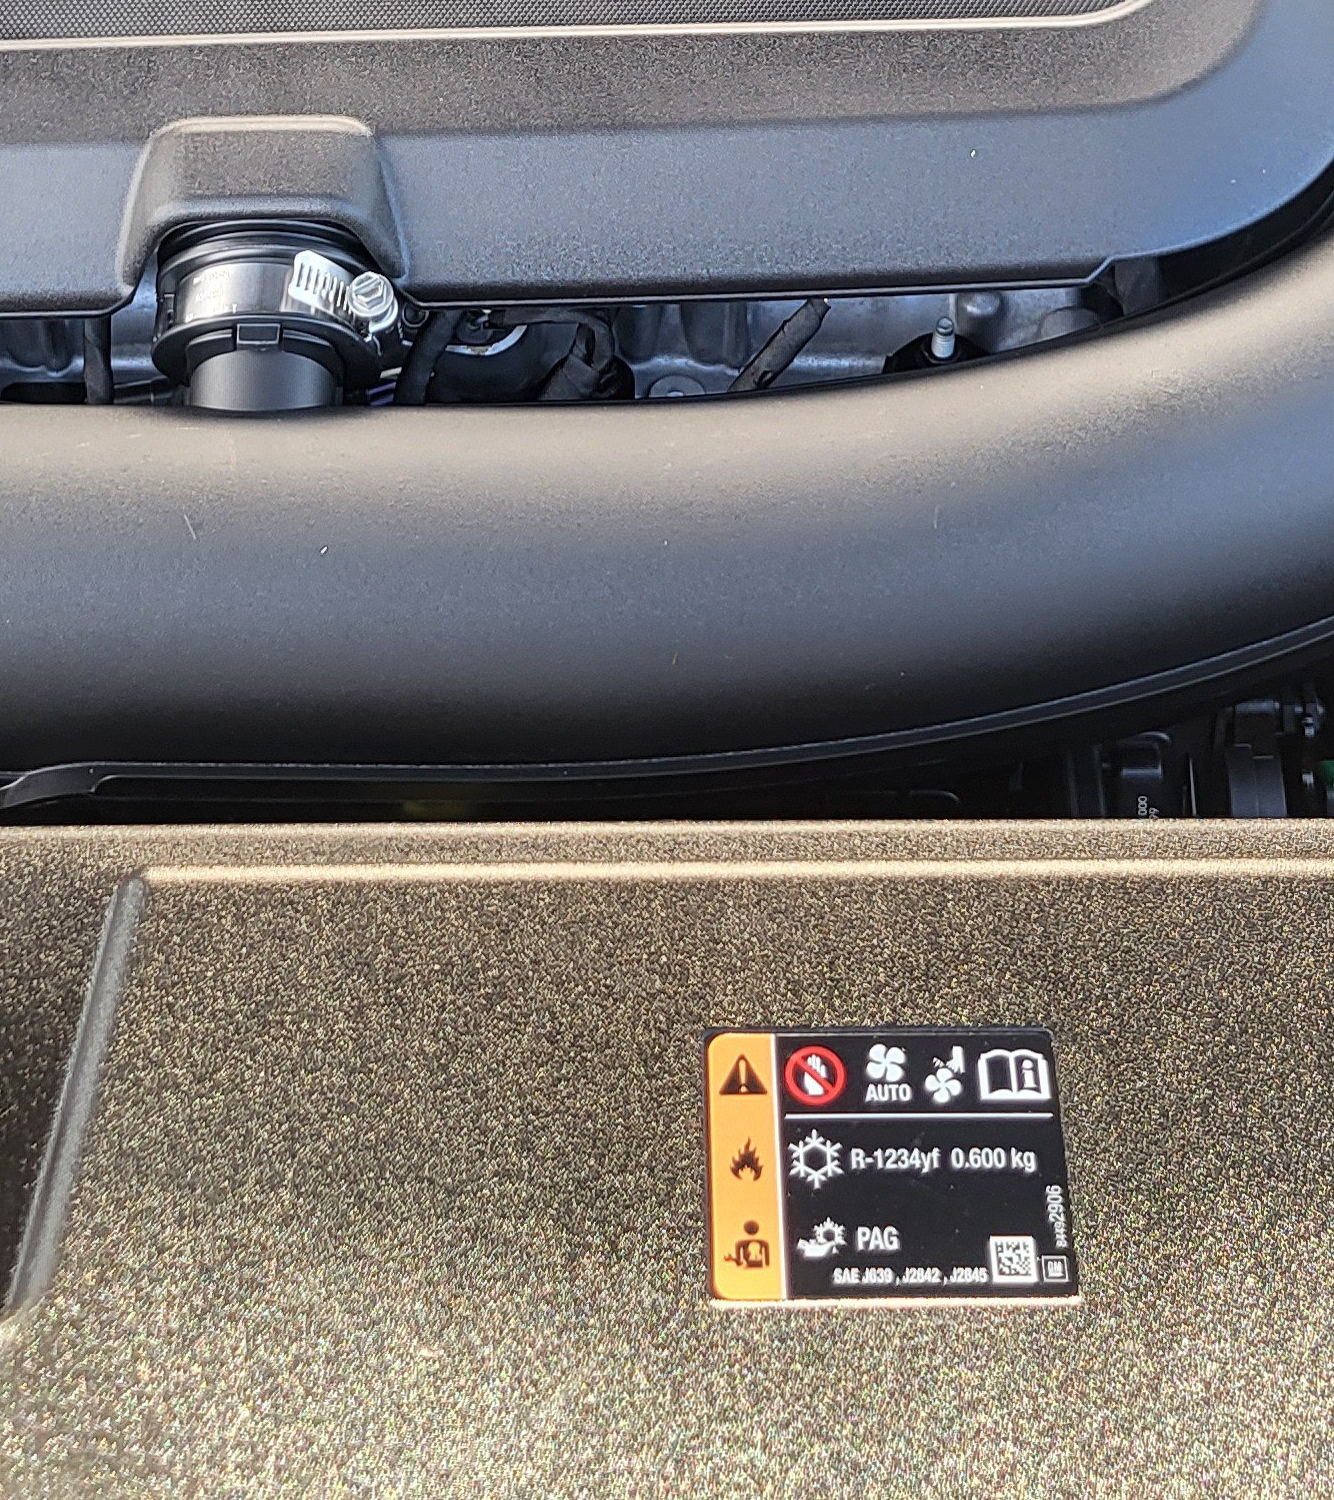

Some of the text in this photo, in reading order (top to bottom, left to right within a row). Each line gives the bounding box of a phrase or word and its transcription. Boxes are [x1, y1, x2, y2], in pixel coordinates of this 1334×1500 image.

[865, 1083, 912, 1102] AUTO
[851, 1147, 1036, 1173] R-1234yf 0.600 kg
[856, 1227, 900, 1250] PAG
[832, 1268, 861, 1284] SAE
[950, 1267, 989, 1284] J2845
